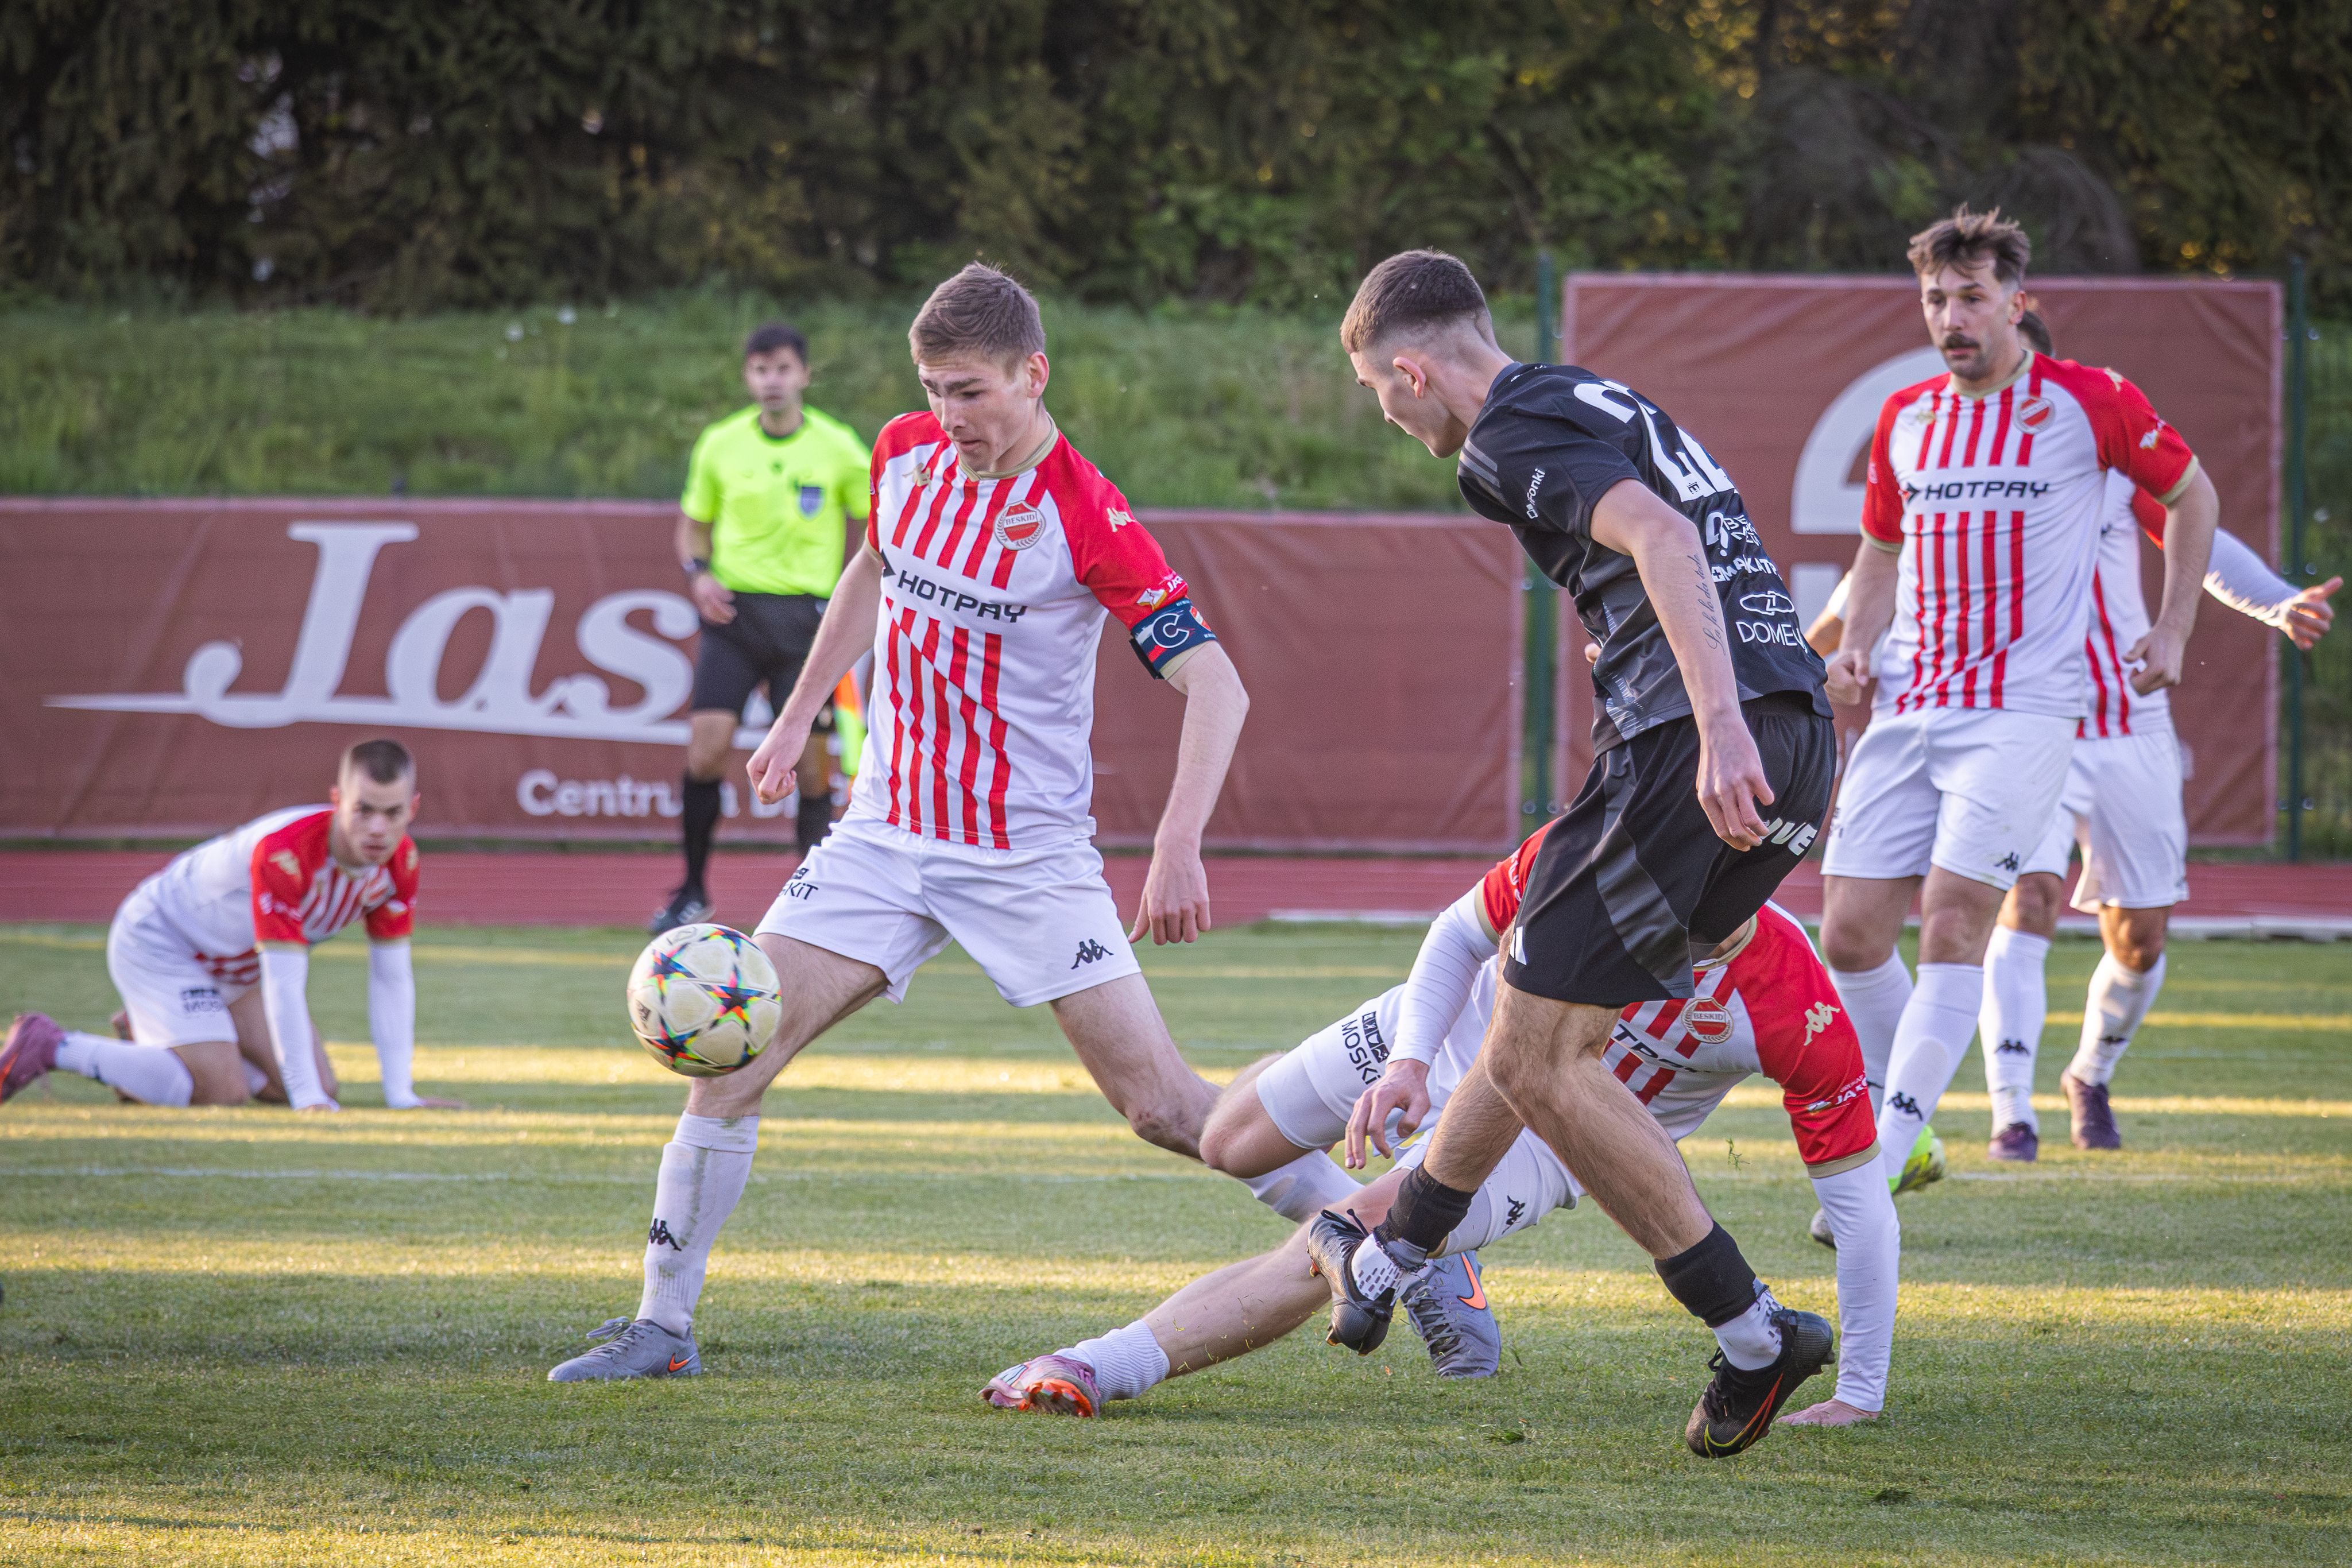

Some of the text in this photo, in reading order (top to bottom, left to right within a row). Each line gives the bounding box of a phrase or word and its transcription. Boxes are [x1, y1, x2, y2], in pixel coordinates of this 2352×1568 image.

[1925, 481, 2049, 501] HOTPAY
[1005, 514, 1035, 525] BESKID
[898, 570, 1028, 623] HOTPAY
[183, 520, 702, 741] Jas
[1152, 613, 1190, 648] C
[1694, 1013, 1723, 1021] BESKID
[1341, 1019, 1381, 1085] MOSKi
